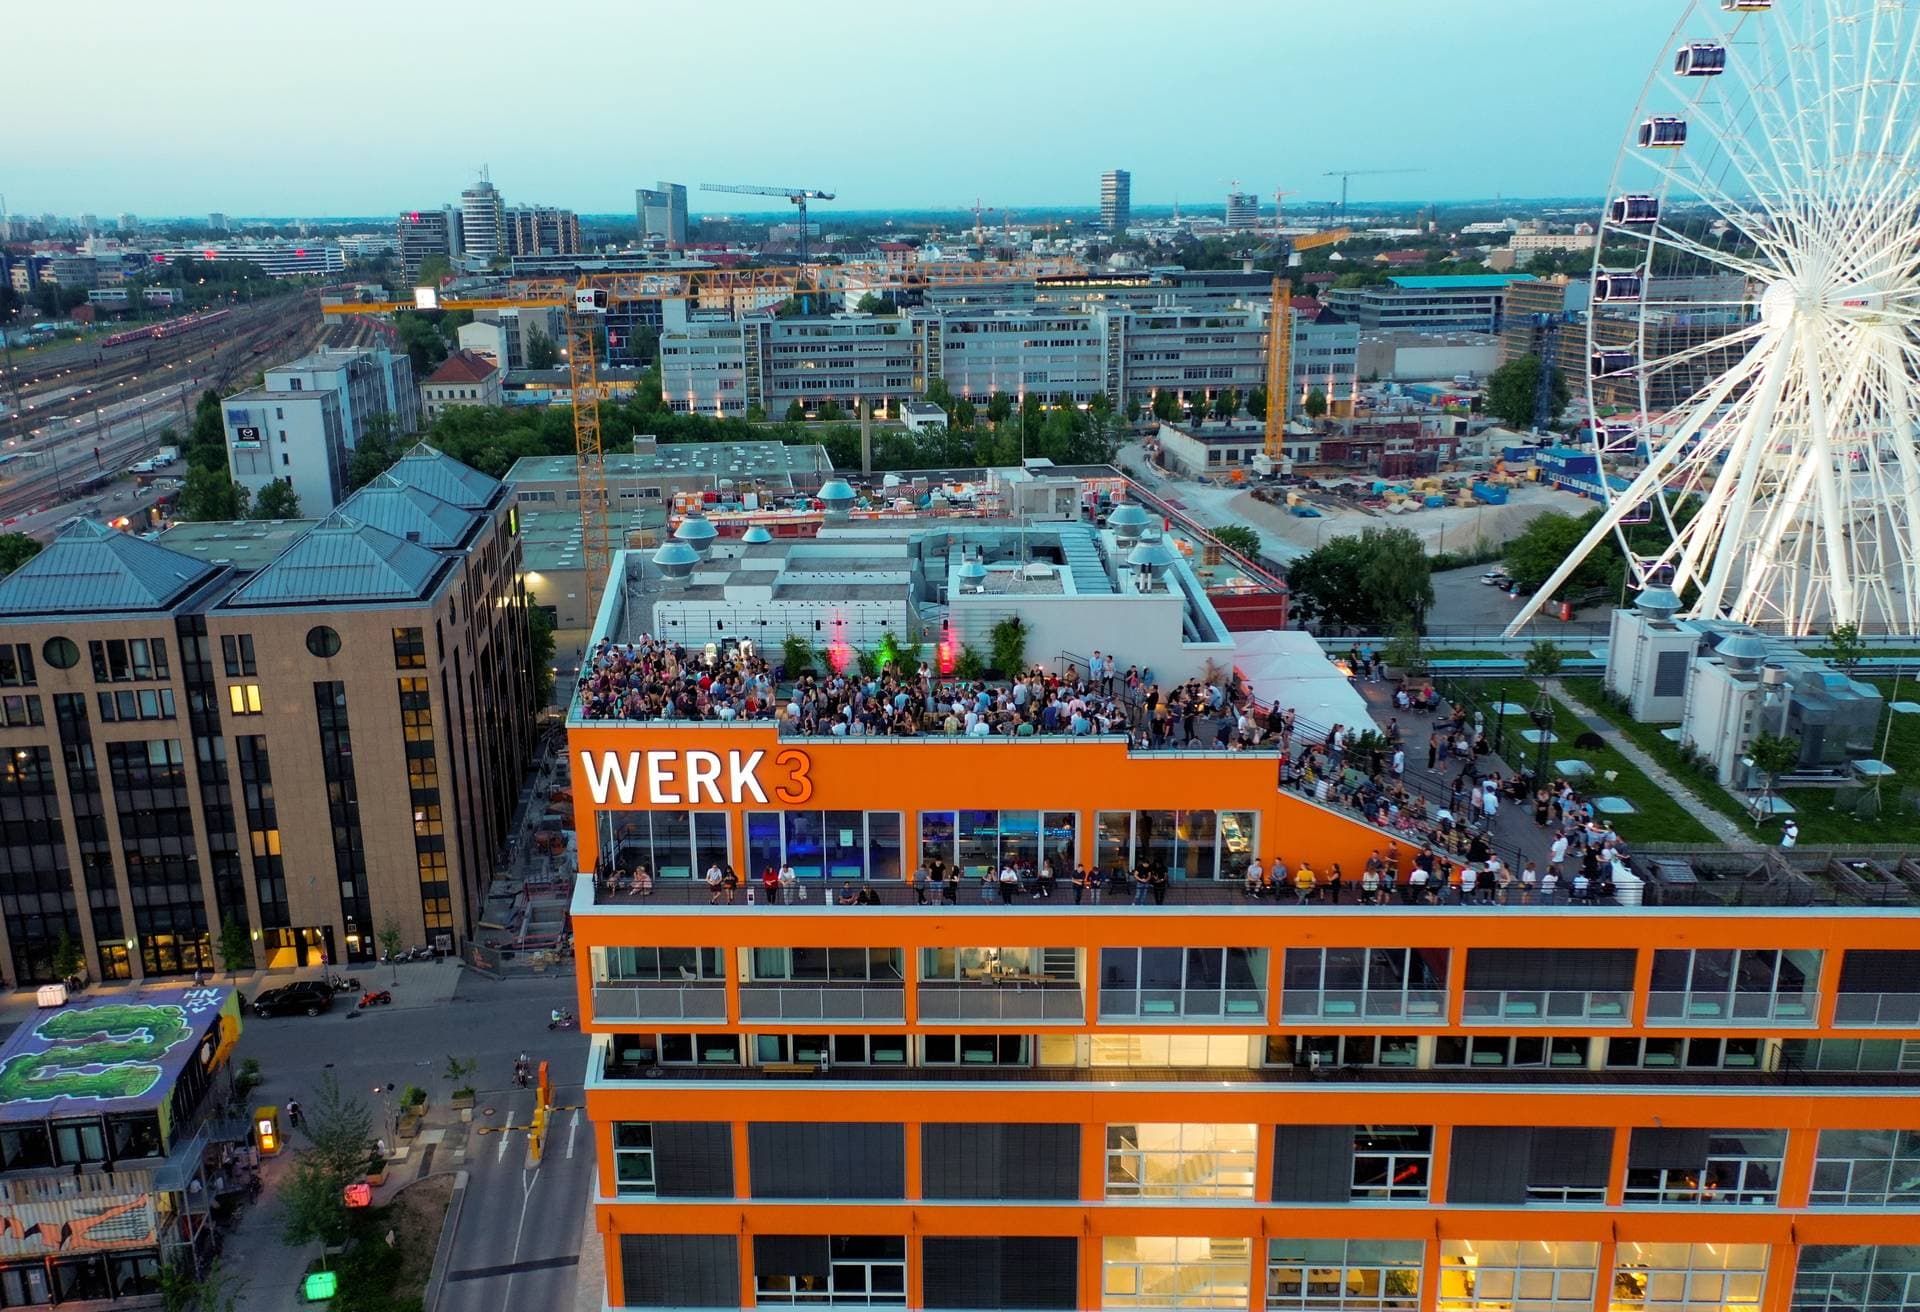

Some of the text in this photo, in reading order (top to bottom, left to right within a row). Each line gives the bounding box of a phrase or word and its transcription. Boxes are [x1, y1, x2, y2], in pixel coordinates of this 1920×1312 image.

[580, 749, 813, 804] WERK 3
[183, 988, 218, 998] HN
[186, 997, 222, 1007] RX
